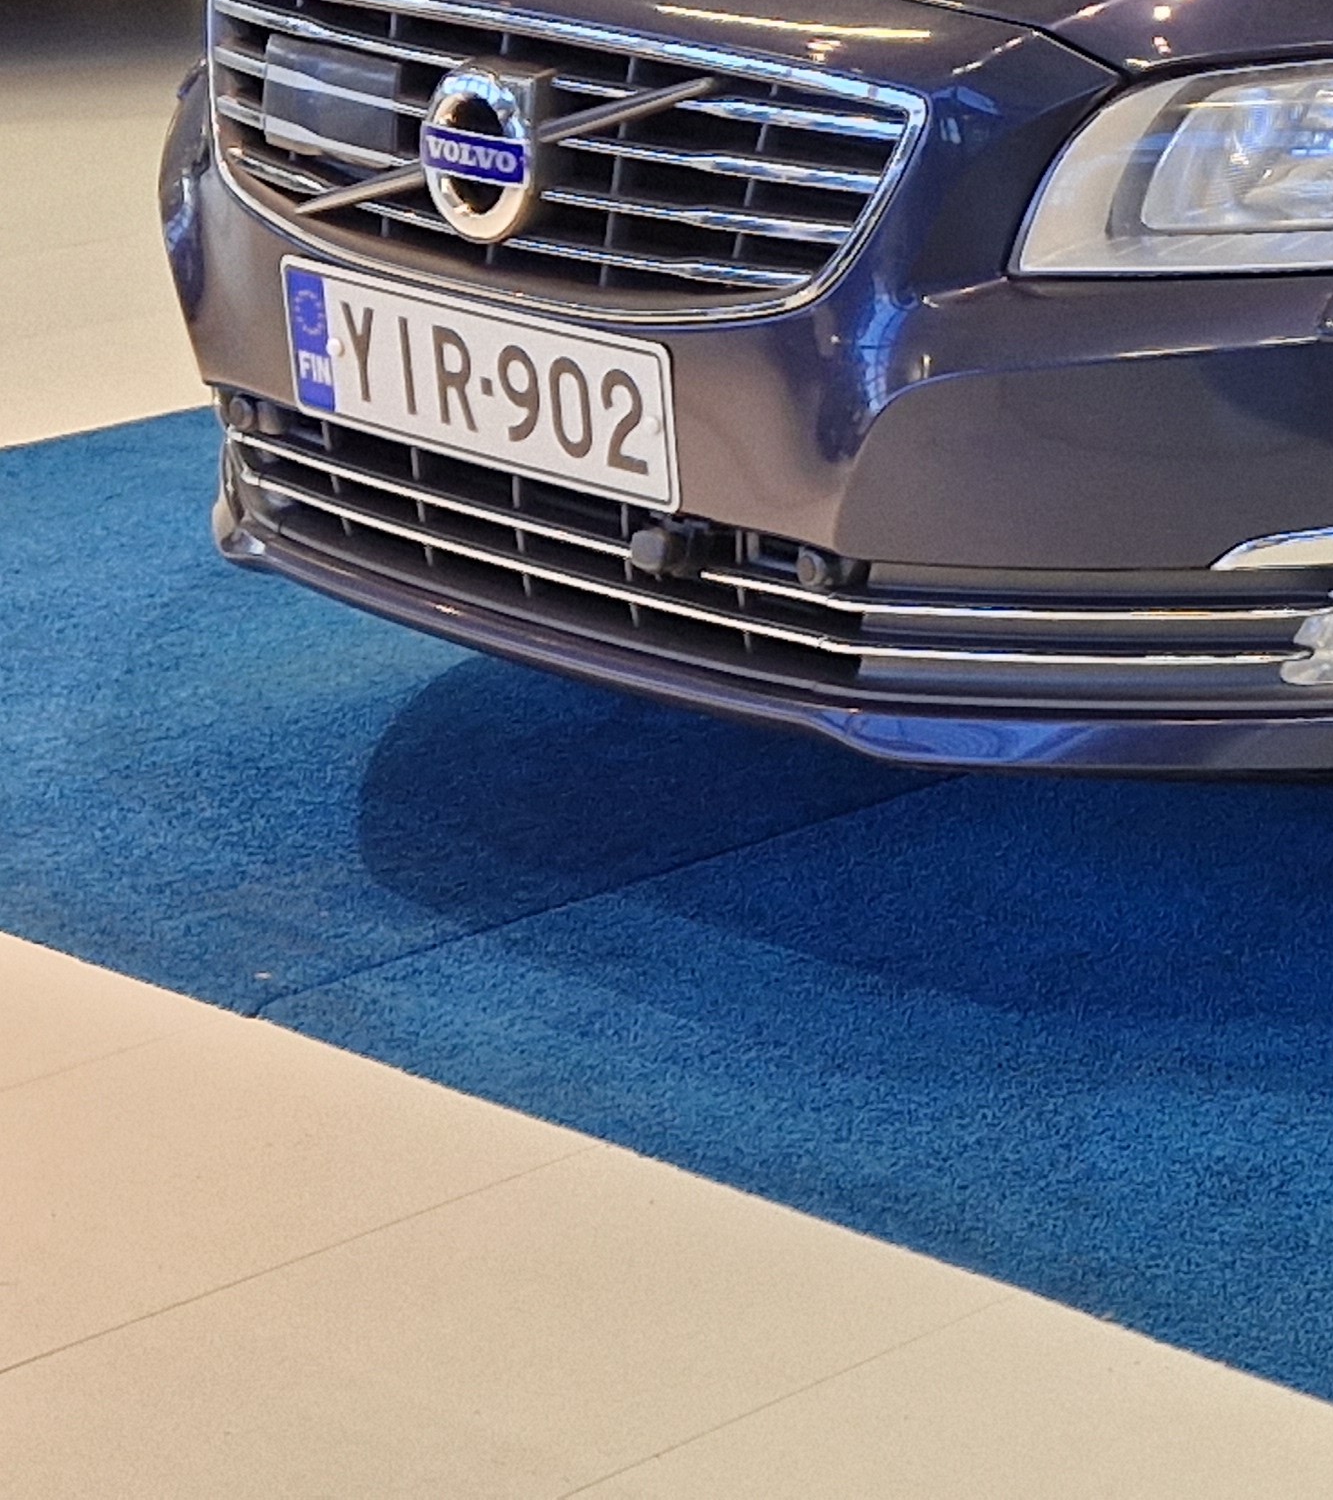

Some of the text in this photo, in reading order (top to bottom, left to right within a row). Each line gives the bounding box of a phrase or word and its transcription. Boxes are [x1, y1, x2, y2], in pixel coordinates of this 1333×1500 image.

[425, 134, 518, 174] VOLVO
[298, 301, 650, 476] FIN YIR-902
